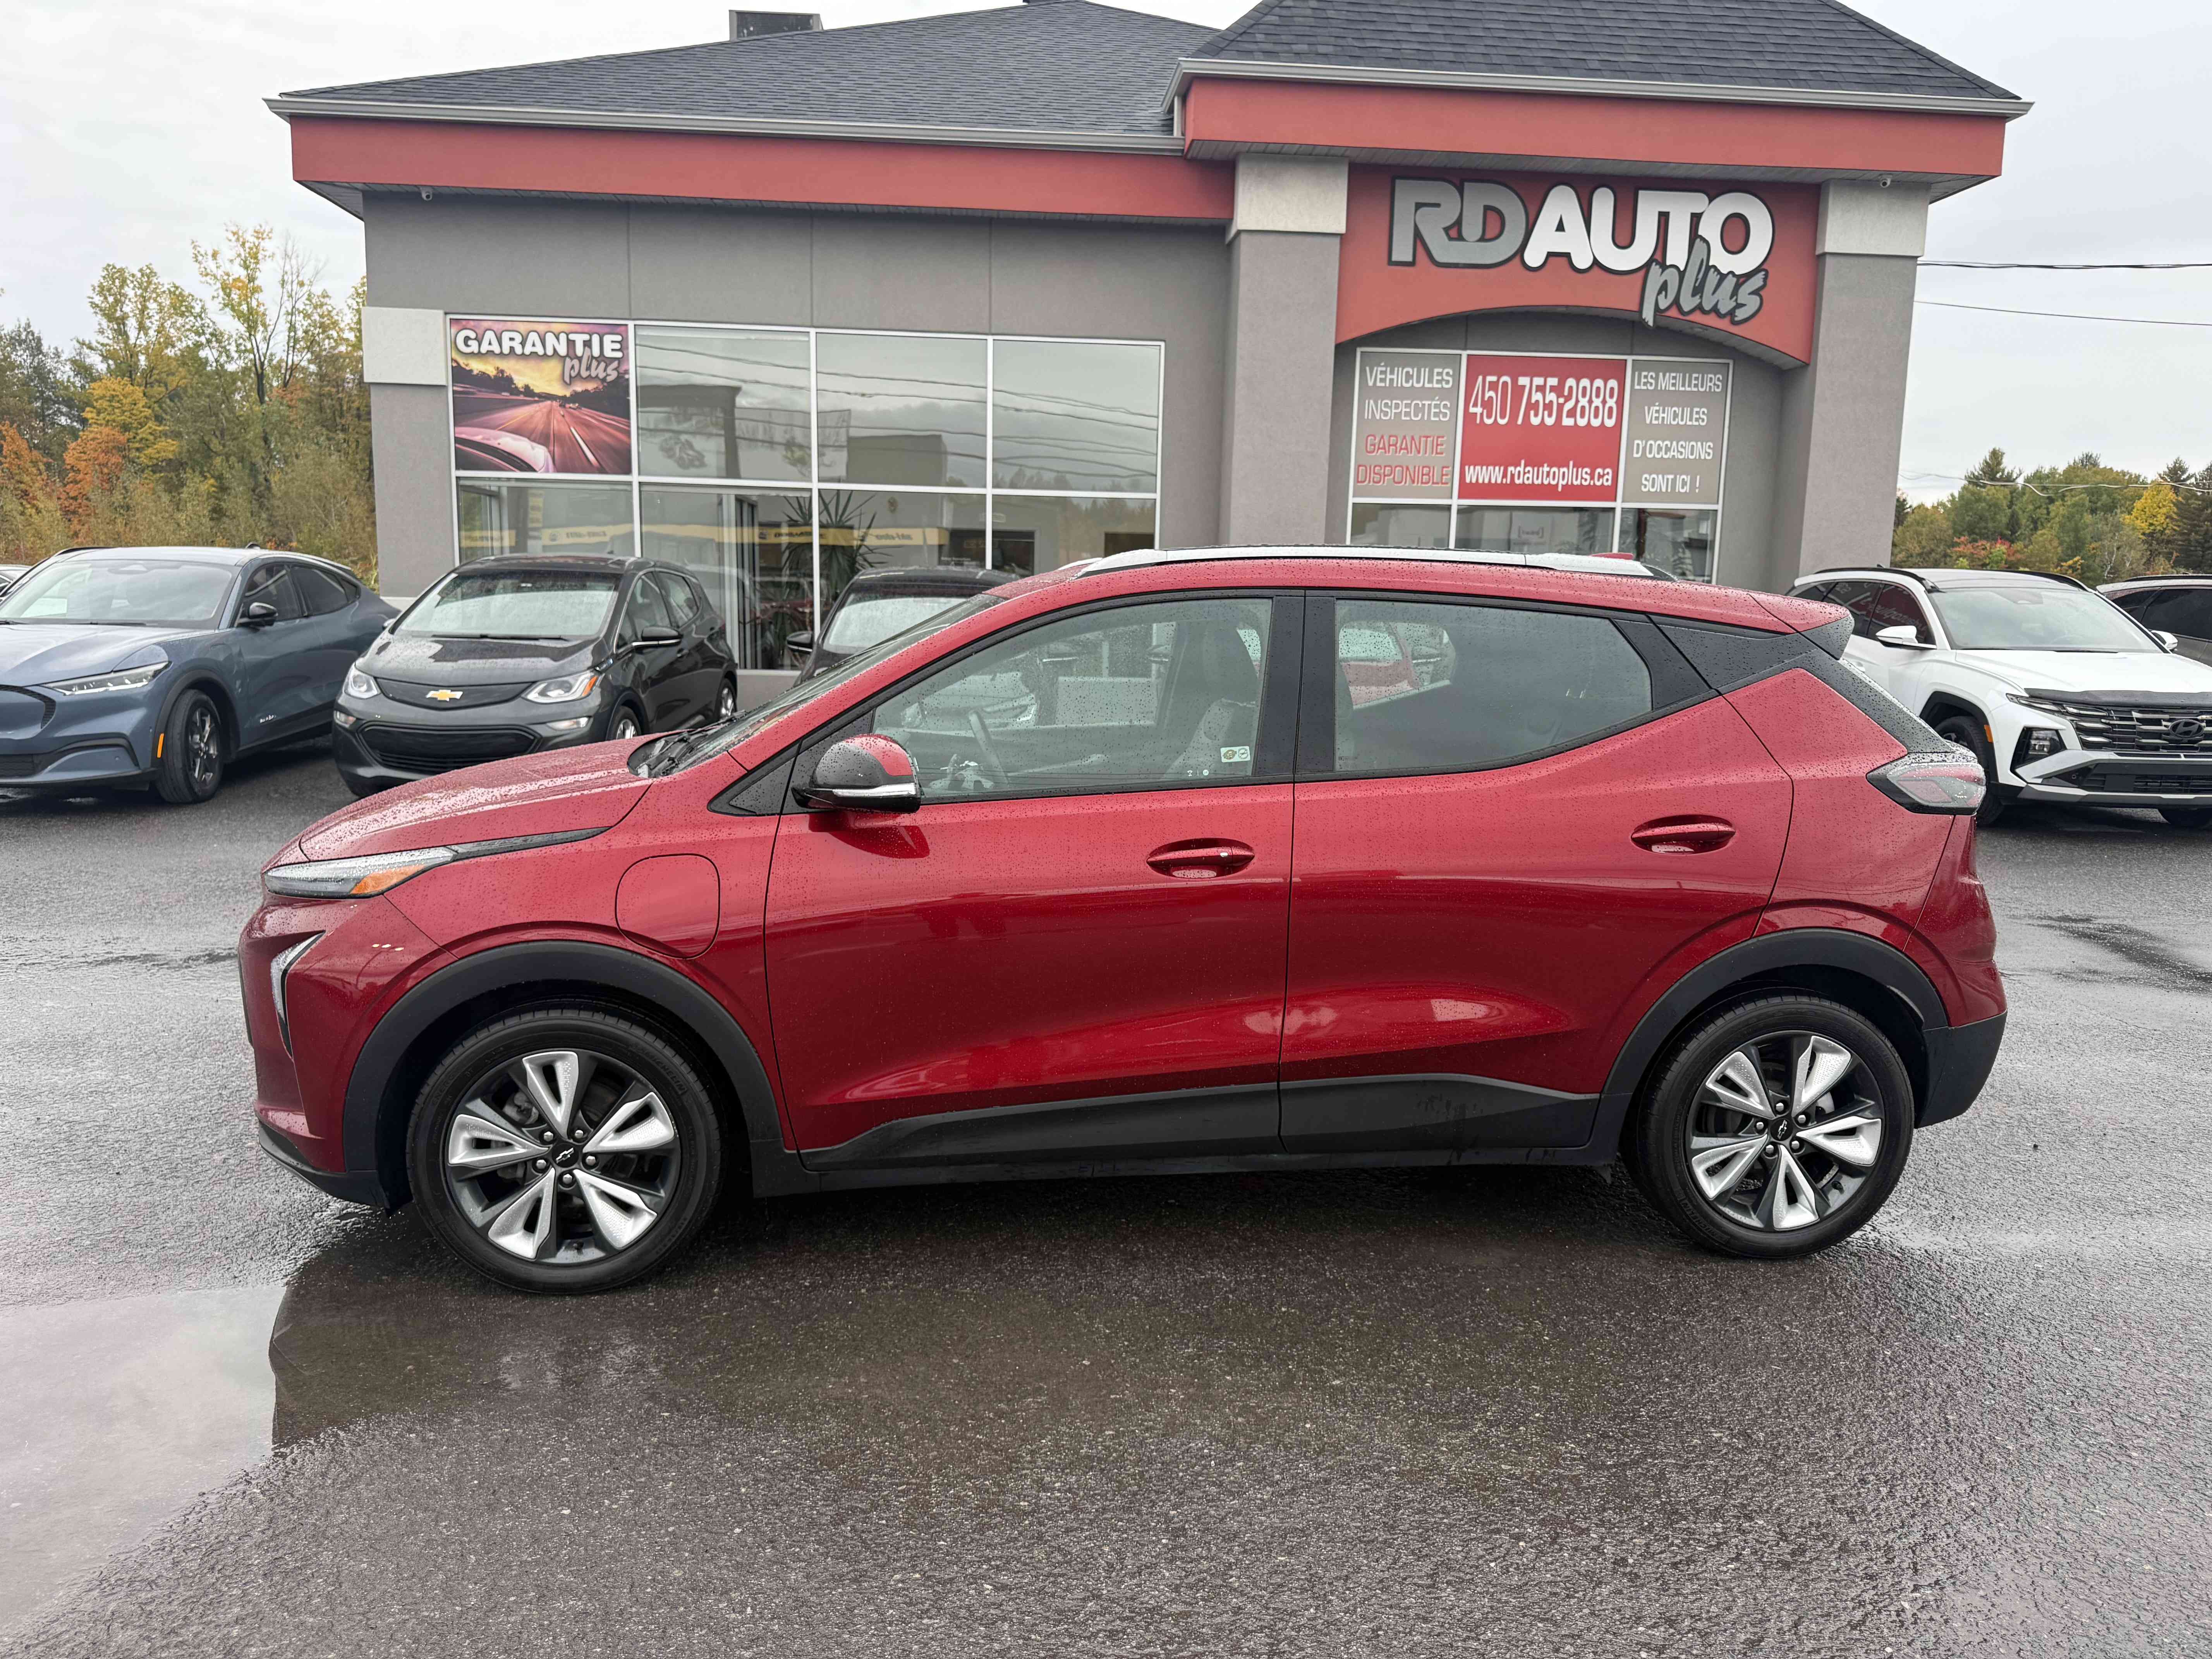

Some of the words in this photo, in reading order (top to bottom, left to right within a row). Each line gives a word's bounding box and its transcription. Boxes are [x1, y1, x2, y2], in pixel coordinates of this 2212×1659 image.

[1639, 234, 1769, 328] plus
[455, 328, 624, 358] GARANTIE
[563, 346, 619, 385] plus
[1365, 362, 1453, 388] VÉHICULES
[1634, 371, 1656, 390] LES
[1657, 372, 1723, 392] MEILLEURS
[1364, 396, 1450, 421] INSPECTÉS
[1468, 374, 1512, 425] 450
[1516, 376, 1619, 428] 755-2888
[1644, 402, 1708, 426] VÉHICULES
[1365, 434, 1447, 457] GARANTIE
[1633, 440, 1714, 460] D'OCCASIONS
[1357, 464, 1451, 486] DISPONIBLE
[1465, 459, 1612, 492] www.rdautoplus.ca
[1641, 474, 1674, 492] SONT
[1675, 474, 1690, 493] ICI
